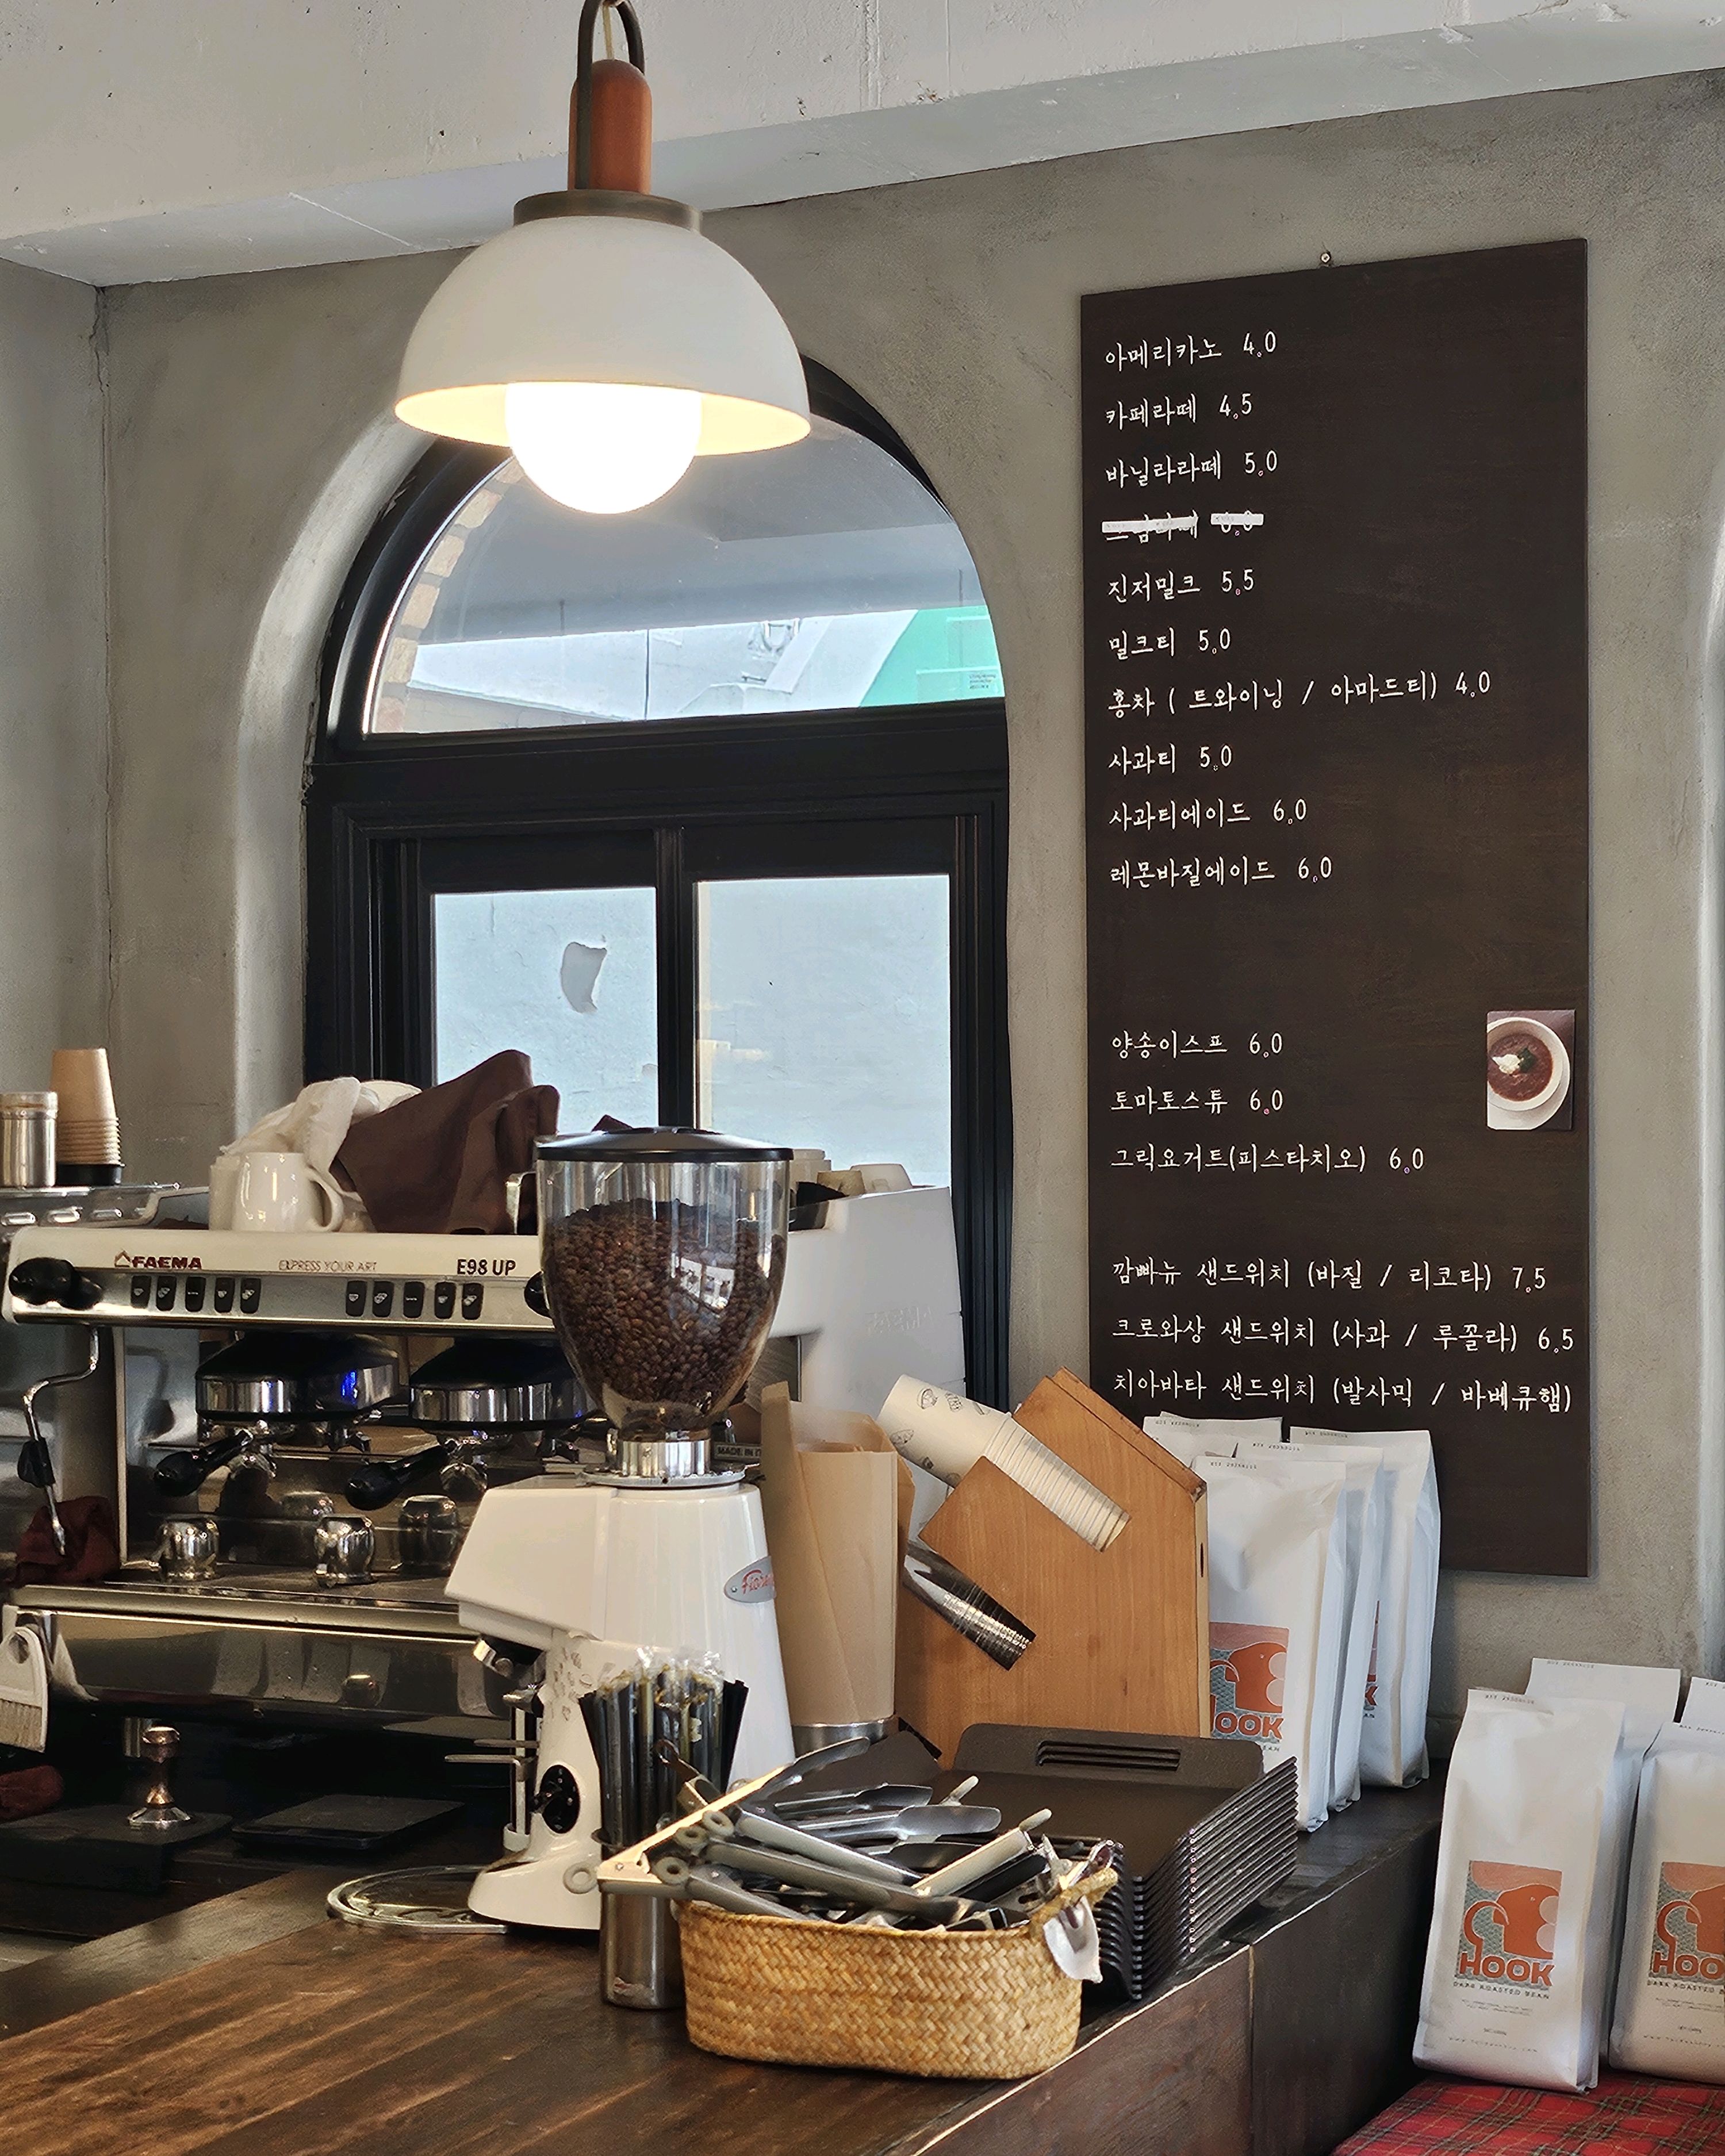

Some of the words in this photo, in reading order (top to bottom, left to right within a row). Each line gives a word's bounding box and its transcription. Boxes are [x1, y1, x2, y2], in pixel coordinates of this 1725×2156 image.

[1106, 335, 1222, 372] 아메리카노
[1243, 331, 1276, 358] 4.0
[1106, 393, 1196, 430] 카페라떼
[1219, 393, 1252, 420] 4.5
[1106, 450, 1221, 489] 바닐라라떼
[1245, 450, 1277, 477] 5.0
[1108, 570, 1201, 603] 진저밀크
[1221, 569, 1254, 596] 5.5
[1109, 627, 1174, 660] 밀크티
[1198, 628, 1230, 654] 5.0
[1108, 687, 1155, 718] 홍차
[1189, 678, 1282, 712] 트와이닝
[1301, 680, 1314, 705] /
[1331, 670, 1436, 705] 아마드티)
[1455, 671, 1490, 698] 4.0
[1108, 743, 1175, 776] 사과티
[1200, 745, 1232, 772] 5.0
[1109, 798, 1251, 832] 사과티에이드
[1273, 799, 1306, 824] 6.0
[1110, 856, 1275, 889] 레몬바질에이드
[1298, 856, 1332, 883] 6.0
[1112, 1030, 1228, 1059] 양송이스프
[1249, 1033, 1282, 1058] 6.0
[1111, 1086, 1228, 1115] 토마토스튜
[1250, 1089, 1283, 1115] 6.0
[1111, 1143, 1366, 1173] 그릭요거트(피스타치오)
[1389, 1148, 1424, 1174] 6.0
[132, 1256, 202, 1269] FAEMA
[278, 1260, 321, 1272] EXPRESS
[324, 1260, 354, 1272] YOUR
[356, 1261, 377, 1272] ART
[457, 1259, 488, 1275] E98
[492, 1259, 516, 1276] UP
[1113, 1256, 1182, 1285] 깜빠뉴
[1197, 1257, 1289, 1288] 샌드위치
[1308, 1259, 1362, 1289] (바질
[1379, 1264, 1393, 1287] /
[1409, 1260, 1491, 1292] 리코타)
[1512, 1267, 1546, 1293] 7.5
[1112, 1314, 1206, 1344] 크로와상
[1221, 1315, 1313, 1347] 샌드위치
[1333, 1319, 1390, 1349] (사과
[1405, 1323, 1418, 1346] /
[1433, 1322, 1517, 1352] 루꼴라)
[1538, 1327, 1573, 1353] 6.5
[1113, 1368, 1207, 1401] 치아바타
[1221, 1372, 1314, 1404] 샌드위치
[1333, 1376, 1412, 1407] (발사믹
[1431, 1382, 1445, 1406] /
[1460, 1380, 1571, 1413] 바베큐햄)
[1459, 1952, 1555, 1987] HOOK
